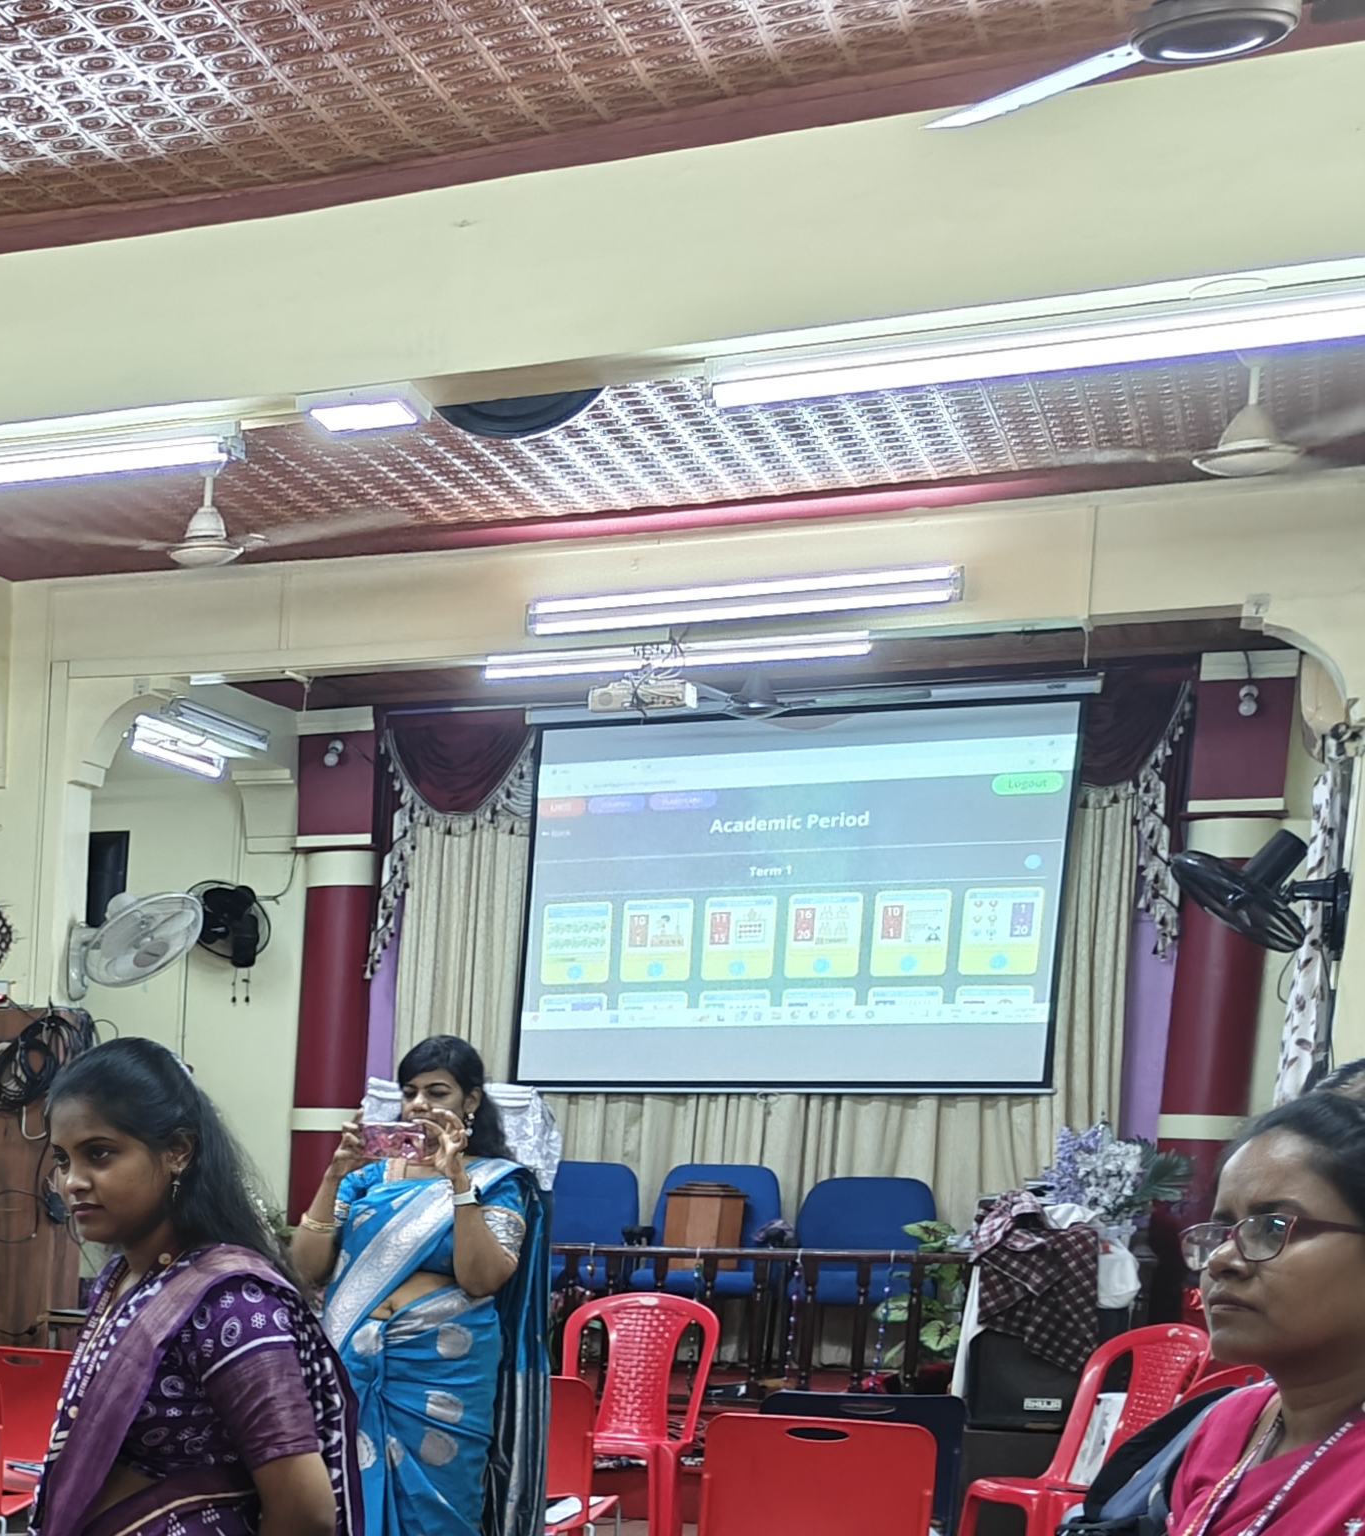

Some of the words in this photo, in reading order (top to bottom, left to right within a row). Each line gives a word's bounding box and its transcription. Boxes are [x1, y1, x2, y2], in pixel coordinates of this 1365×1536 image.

[1008, 777, 1047, 791] Logout
[709, 814, 802, 834] Academic
[807, 811, 870, 829] Period
[749, 866, 783, 877] Term
[785, 865, 792, 875] 1
